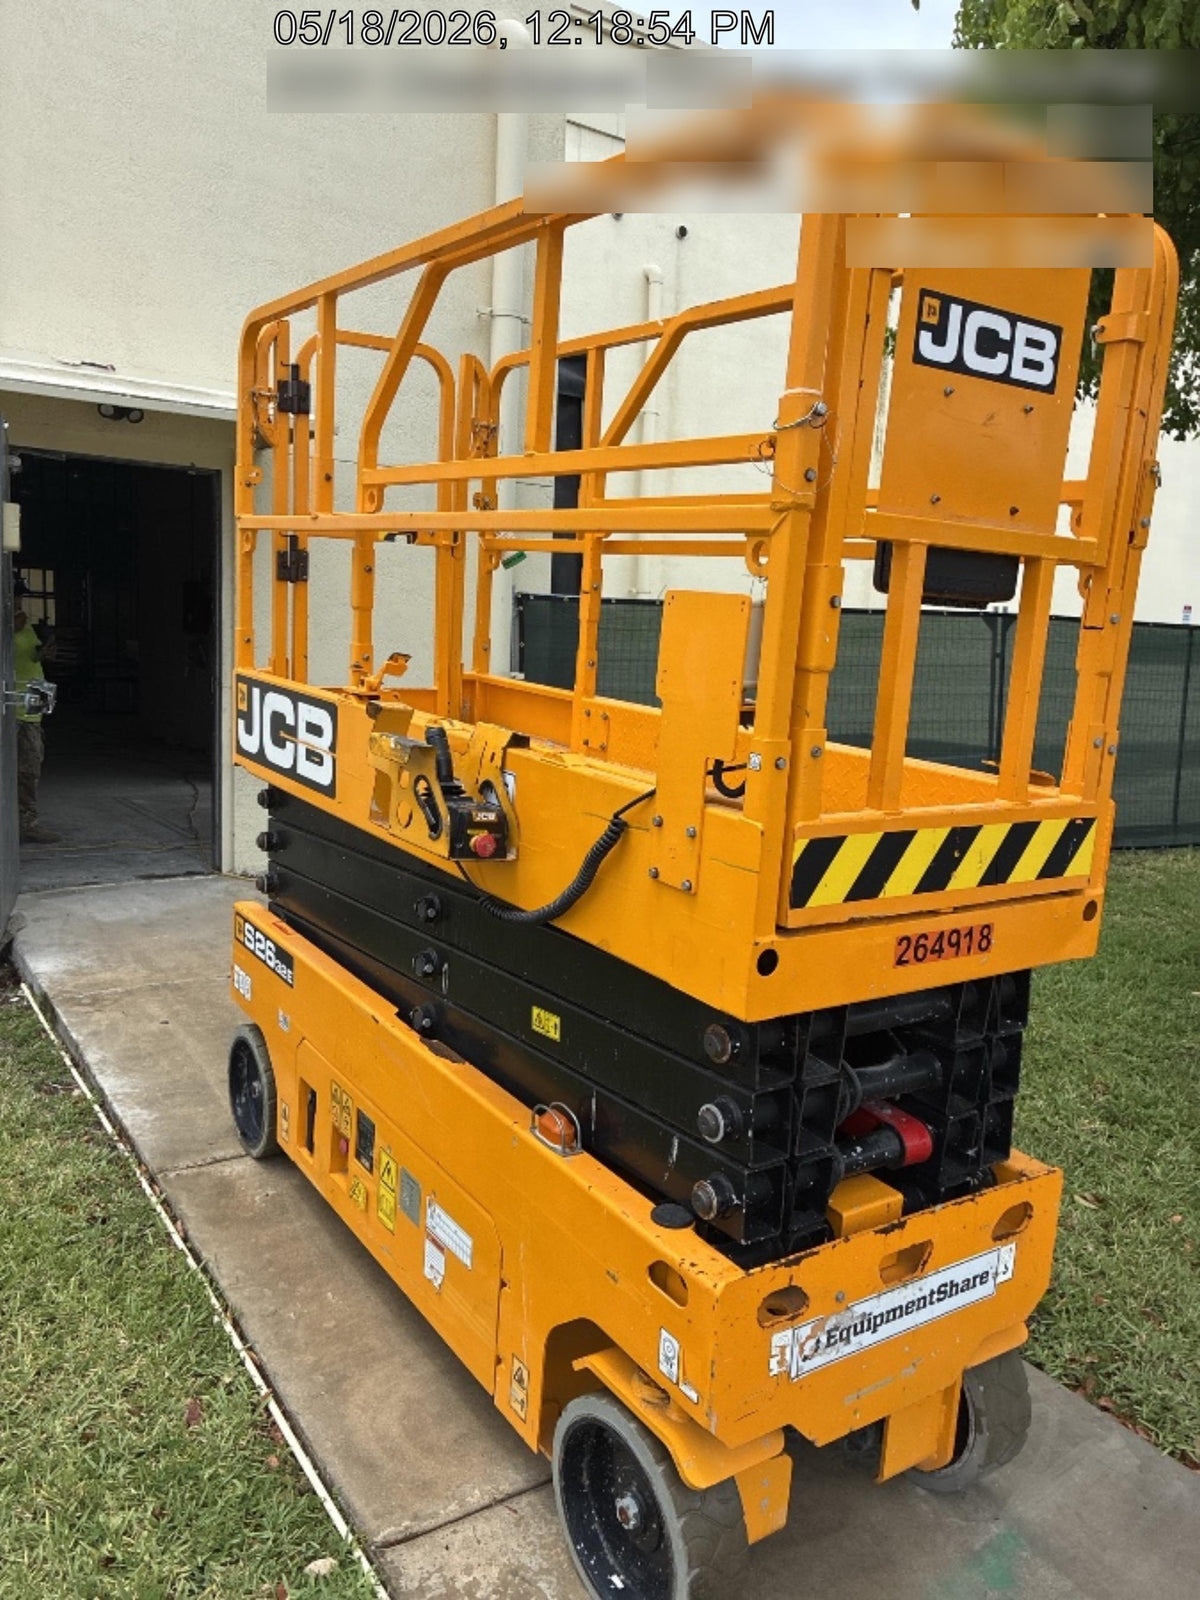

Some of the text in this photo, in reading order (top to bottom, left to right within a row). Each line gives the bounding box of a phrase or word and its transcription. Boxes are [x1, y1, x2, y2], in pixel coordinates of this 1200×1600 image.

[918, 303, 1057, 386] JCB
[237, 687, 333, 787] JCB
[895, 923, 992, 966] 264918
[824, 1270, 990, 1349] EquipmentShare
